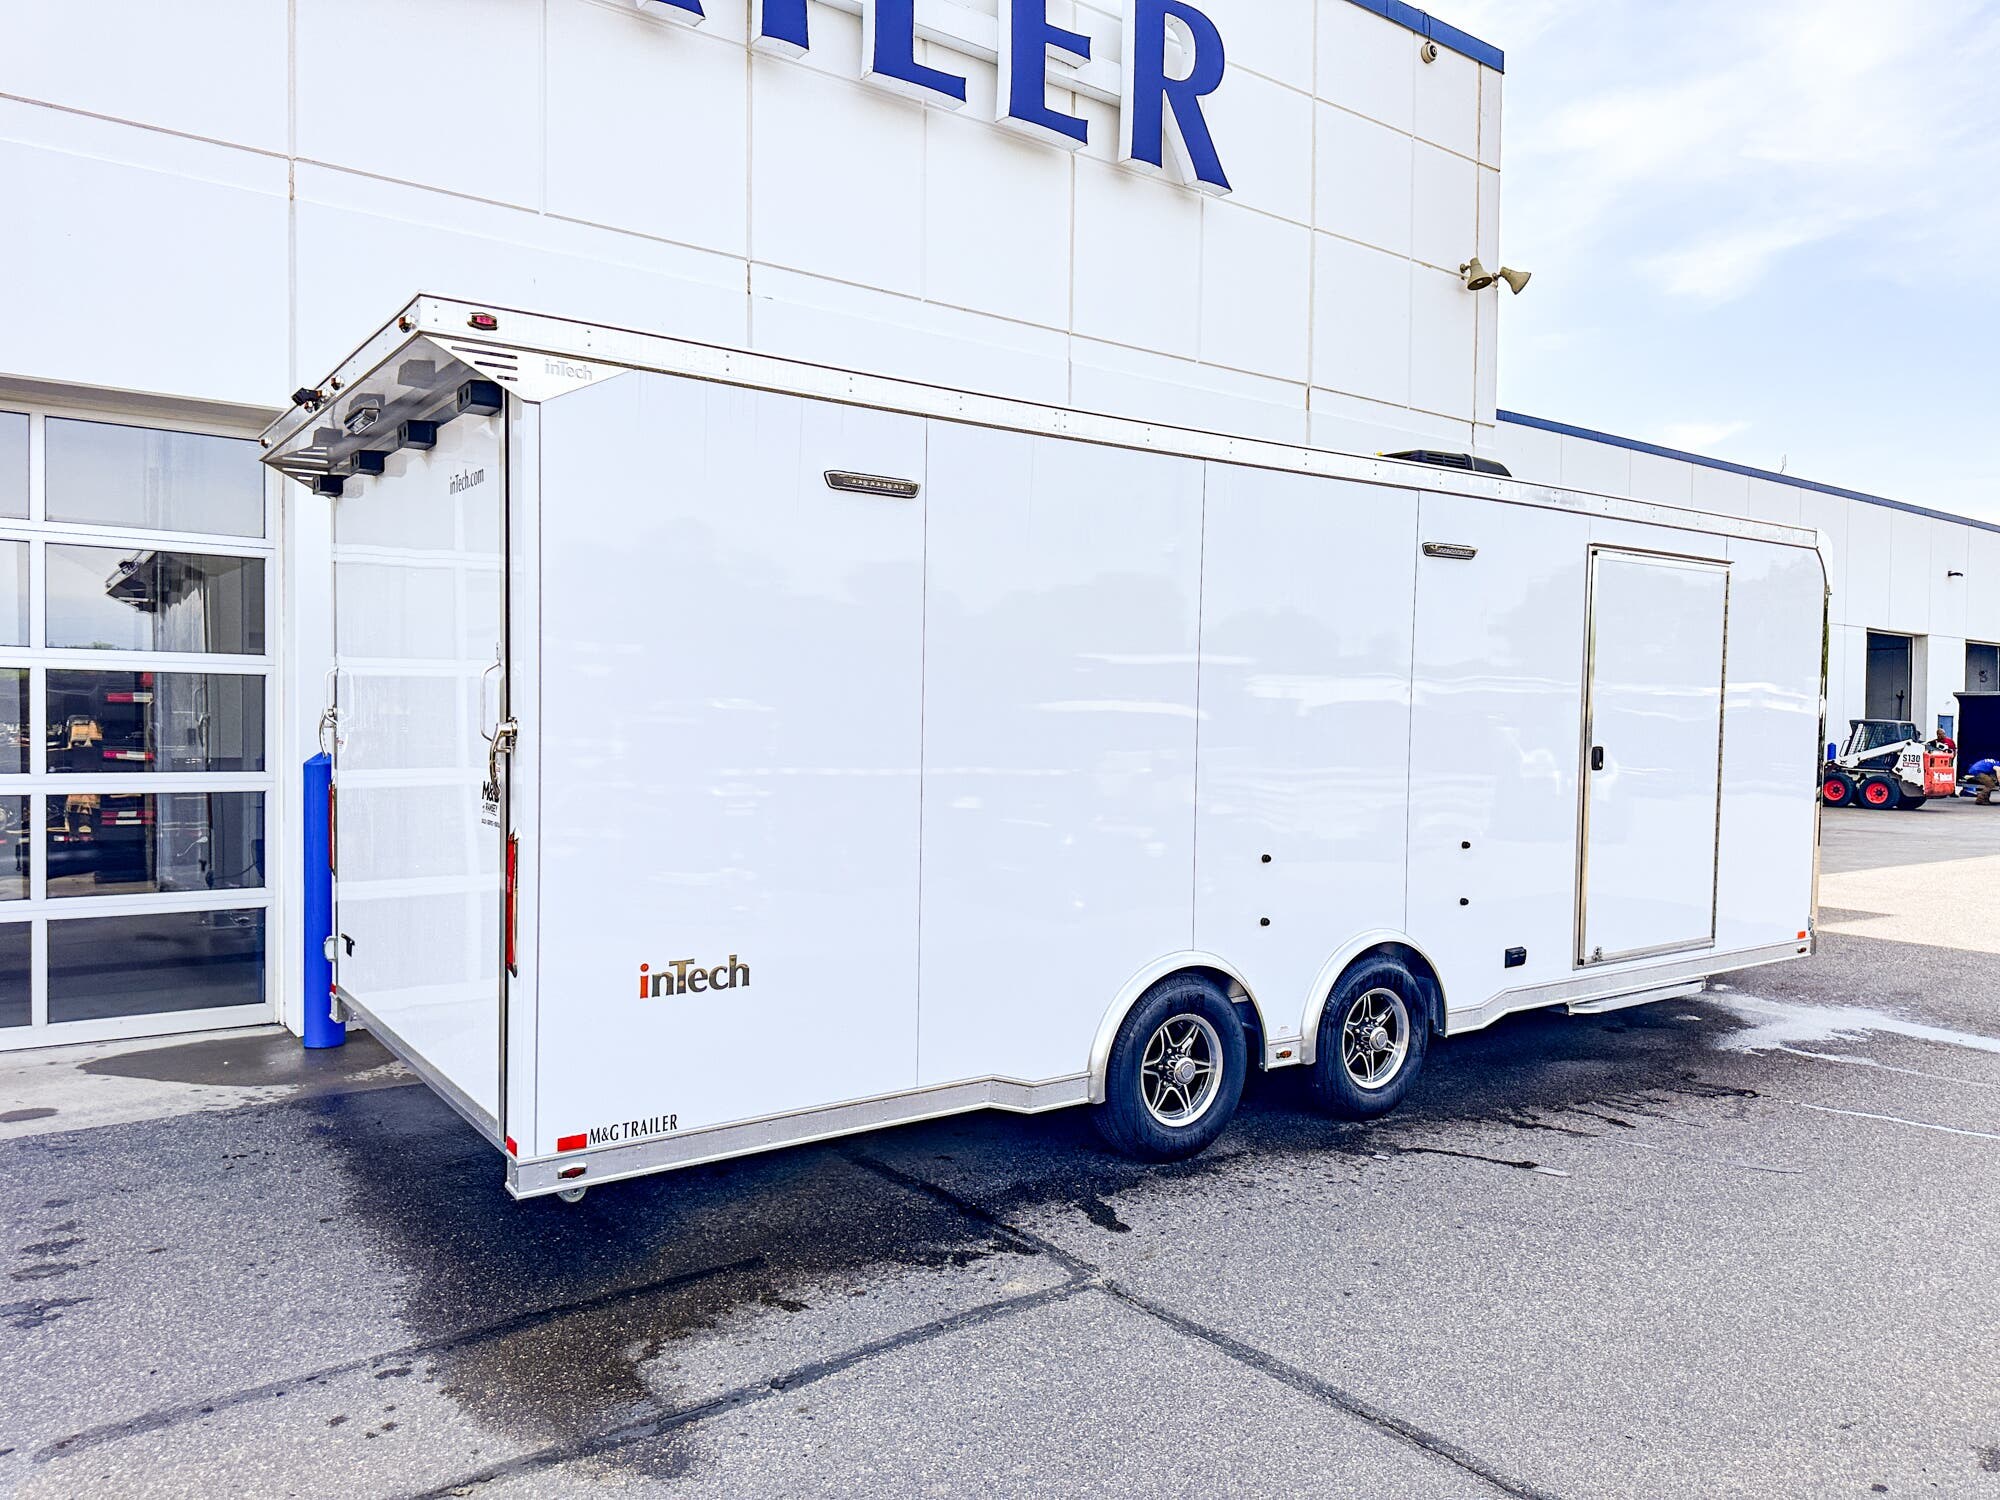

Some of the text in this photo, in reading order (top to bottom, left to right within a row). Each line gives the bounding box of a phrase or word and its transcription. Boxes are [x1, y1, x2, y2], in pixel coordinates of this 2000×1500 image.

[545, 358, 592, 380] inTech
[449, 468, 484, 495] inTech.com
[1902, 754, 1920, 763] S130
[640, 954, 750, 999] inTech
[589, 1114, 678, 1145] M&G TRAILER
